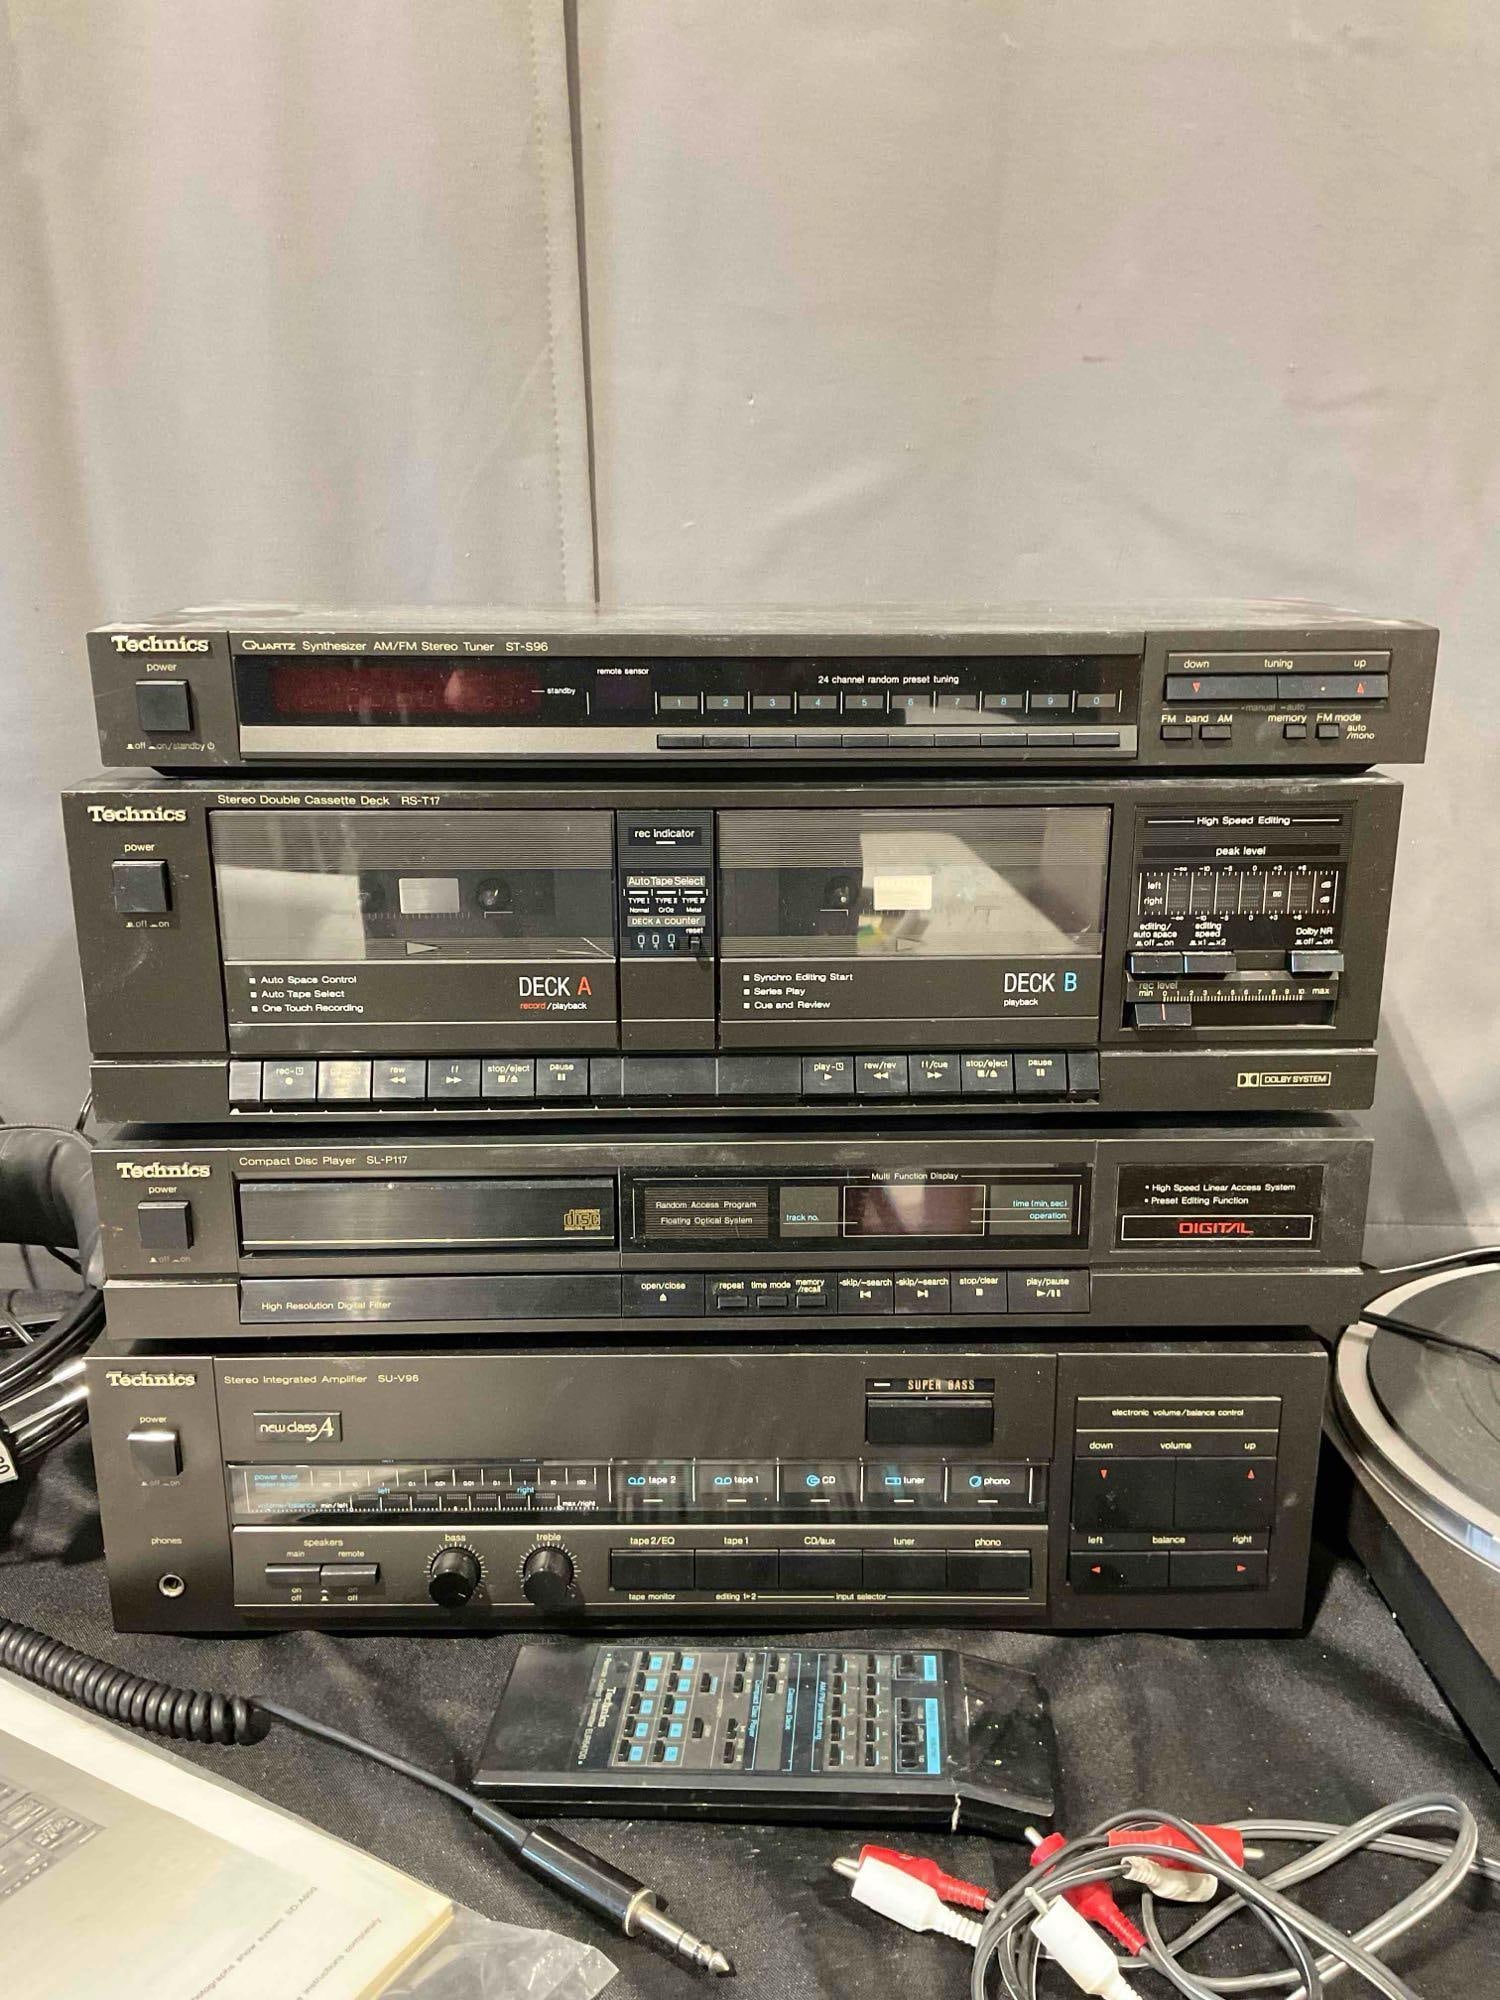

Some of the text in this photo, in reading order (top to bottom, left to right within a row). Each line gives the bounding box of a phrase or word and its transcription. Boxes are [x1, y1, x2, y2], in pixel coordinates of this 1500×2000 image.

[111, 635, 209, 652] Technics
[302, 640, 548, 652] Synthesizer AM/FM Stereo Tuner ST-S96
[147, 663, 177, 672] power
[1184, 659, 1367, 670] down tuning up
[818, 675, 960, 685] 24 channel random preset tuning
[547, 687, 576, 696] standby
[1161, 714, 1233, 723] FM band AM
[1268, 715, 1307, 724] memory
[1334, 714, 1361, 722] mode
[217, 795, 440, 806] Stereo Double Cassette Deck RS-T17
[87, 806, 187, 822] Technics
[1197, 816, 1291, 826] High Speed Editing
[634, 829, 695, 838] rec indicator
[124, 843, 155, 853] power
[1216, 846, 1266, 857] peak level
[1147, 881, 1162, 890] left
[1144, 896, 1163, 906] right
[664, 917, 700, 925] counter
[1295, 926, 1319, 937] Dolby
[261, 975, 357, 986] Auto Space Control
[754, 972, 853, 983] Synchro Editing Start
[1004, 972, 1077, 993] DECK B
[519, 976, 592, 996] DECK A
[1157, 981, 1178, 990] level
[261, 989, 345, 1000] Auto Tape Select
[754, 987, 806, 998] Series Play
[754, 1001, 831, 1010] Cue and Review
[1003, 998, 1039, 1007] playback
[262, 1003, 364, 1014] One Touch Recording
[549, 1064, 574, 1072] pause
[965, 1059, 1008, 1069] stop/eject
[1028, 1059, 1053, 1068] pause
[487, 1064, 530, 1074] stop/eject
[239, 1155, 408, 1167] Compact Disc Player SL-P117
[117, 1163, 211, 1178] Technics
[871, 1172, 959, 1182] Multi Function Display
[148, 1185, 178, 1195] power
[1152, 1183, 1296, 1193] High Speed Linear Access System
[656, 1201, 757, 1211] Random Access Program
[1151, 1196, 1249, 1206] Preset Editing Function
[661, 1216, 753, 1226] Floating Optical System
[786, 1213, 805, 1222] track
[1029, 1212, 1067, 1220] operation
[1178, 1222, 1255, 1234] DIGITAL
[641, 1282, 686, 1290] open/close
[719, 1281, 744, 1291] repeat
[751, 1281, 791, 1289] time mode
[261, 1300, 392, 1312] High Resolution Digital Filter
[105, 1372, 195, 1387] Technics
[224, 1374, 419, 1385] Stereo Integrated Amplifier SU-V96
[908, 1380, 975, 1390] SUPER BASS
[1153, 1409, 1215, 1417] volume/balance
[140, 1415, 167, 1425] power
[260, 1422, 317, 1433] new class
[1089, 1441, 1257, 1451] down volume up
[649, 1476, 668, 1484] tape
[734, 1475, 753, 1484] tape
[822, 1476, 836, 1484] CD
[903, 1476, 925, 1484] tuner
[984, 1477, 1011, 1486] phono
[151, 1537, 182, 1547] phones
[444, 1534, 466, 1542] bass
[536, 1533, 561, 1542] treble
[630, 1537, 649, 1546] tape
[723, 1537, 743, 1546] tape
[804, 1537, 836, 1545] CD/aux
[893, 1537, 915, 1545] tuner
[974, 1538, 1002, 1547] phono
[1088, 1535, 1252, 1544] left balance right
[304, 1539, 344, 1548] speakers
[715, 1593, 740, 1601] editing
[597, 1686, 617, 1728] Technics
